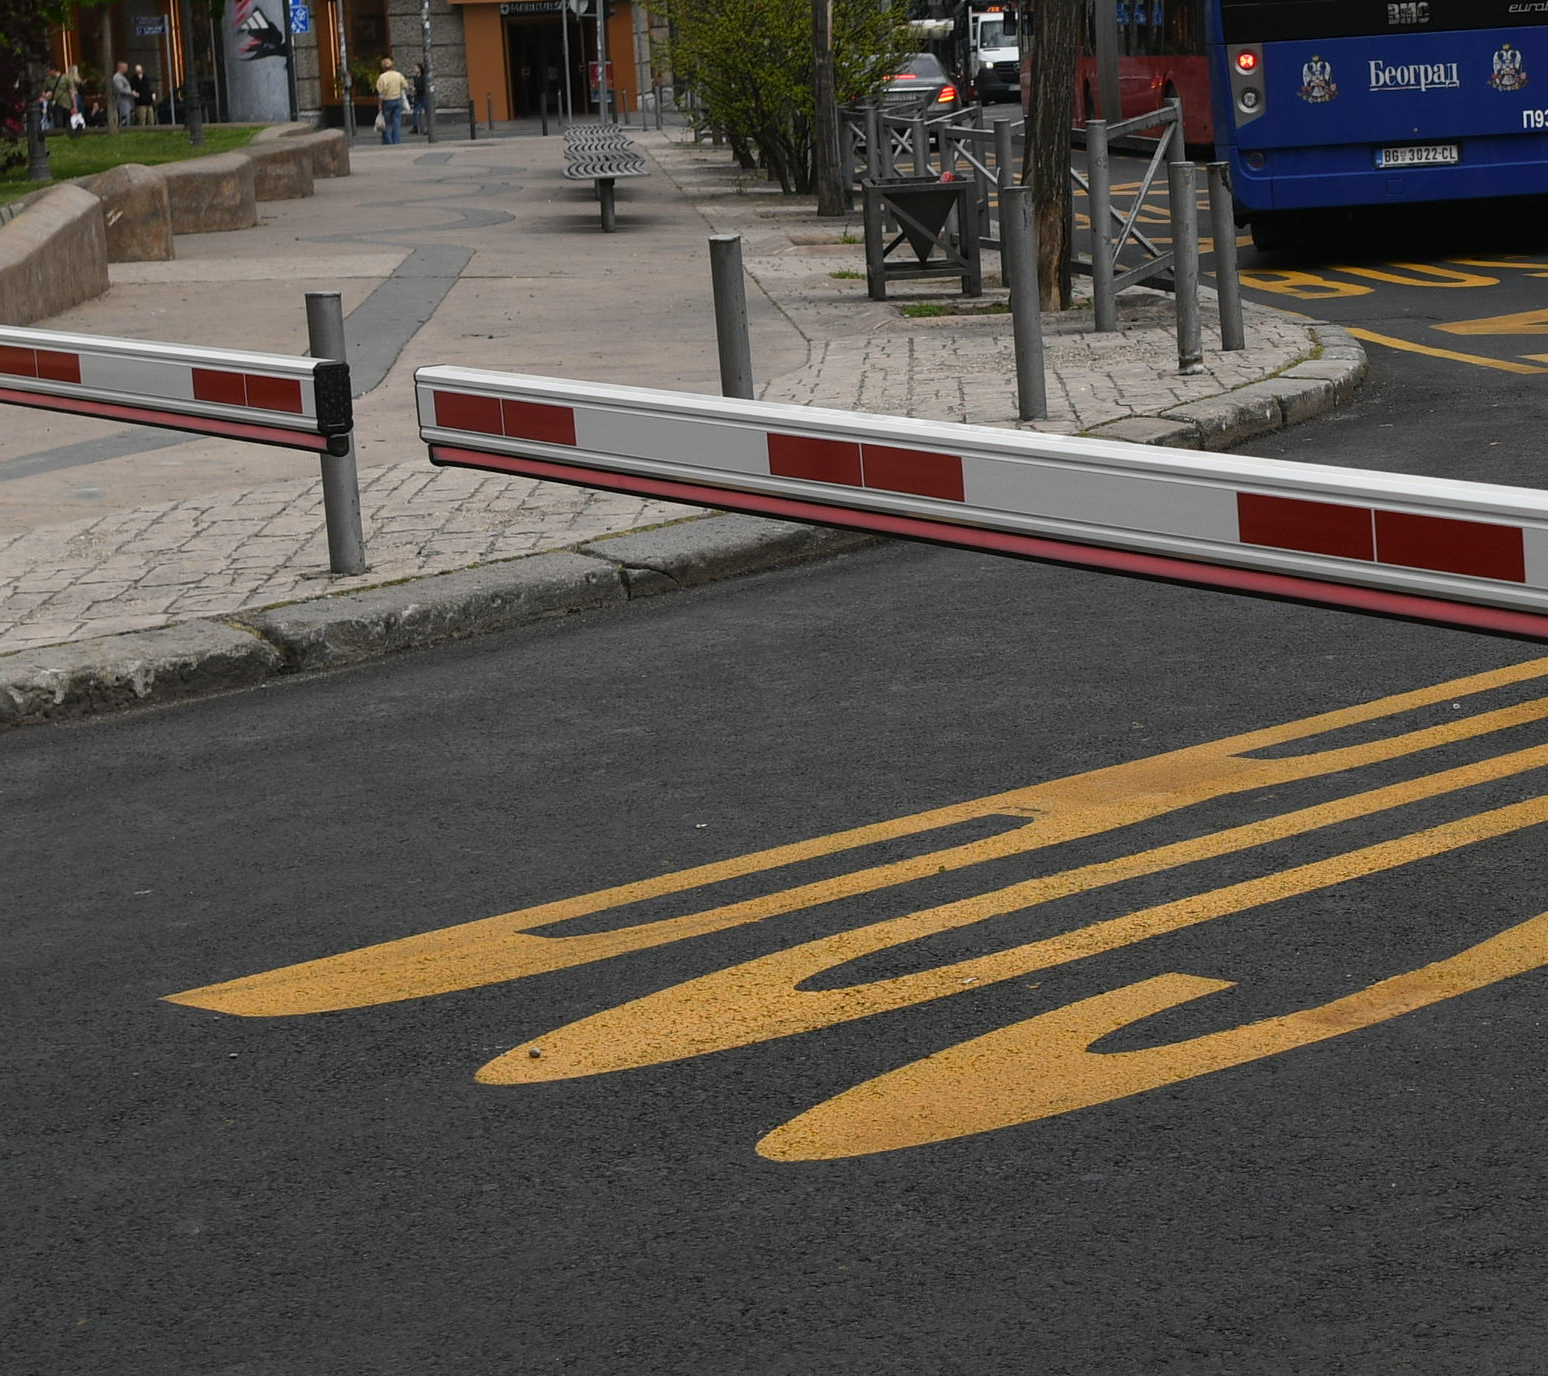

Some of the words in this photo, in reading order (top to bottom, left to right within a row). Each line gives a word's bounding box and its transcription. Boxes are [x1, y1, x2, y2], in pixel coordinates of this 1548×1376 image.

[1387, 2, 1430, 24] BMC
[1368, 60, 1460, 91] Београд
[1384, 149, 1399, 162] BG
